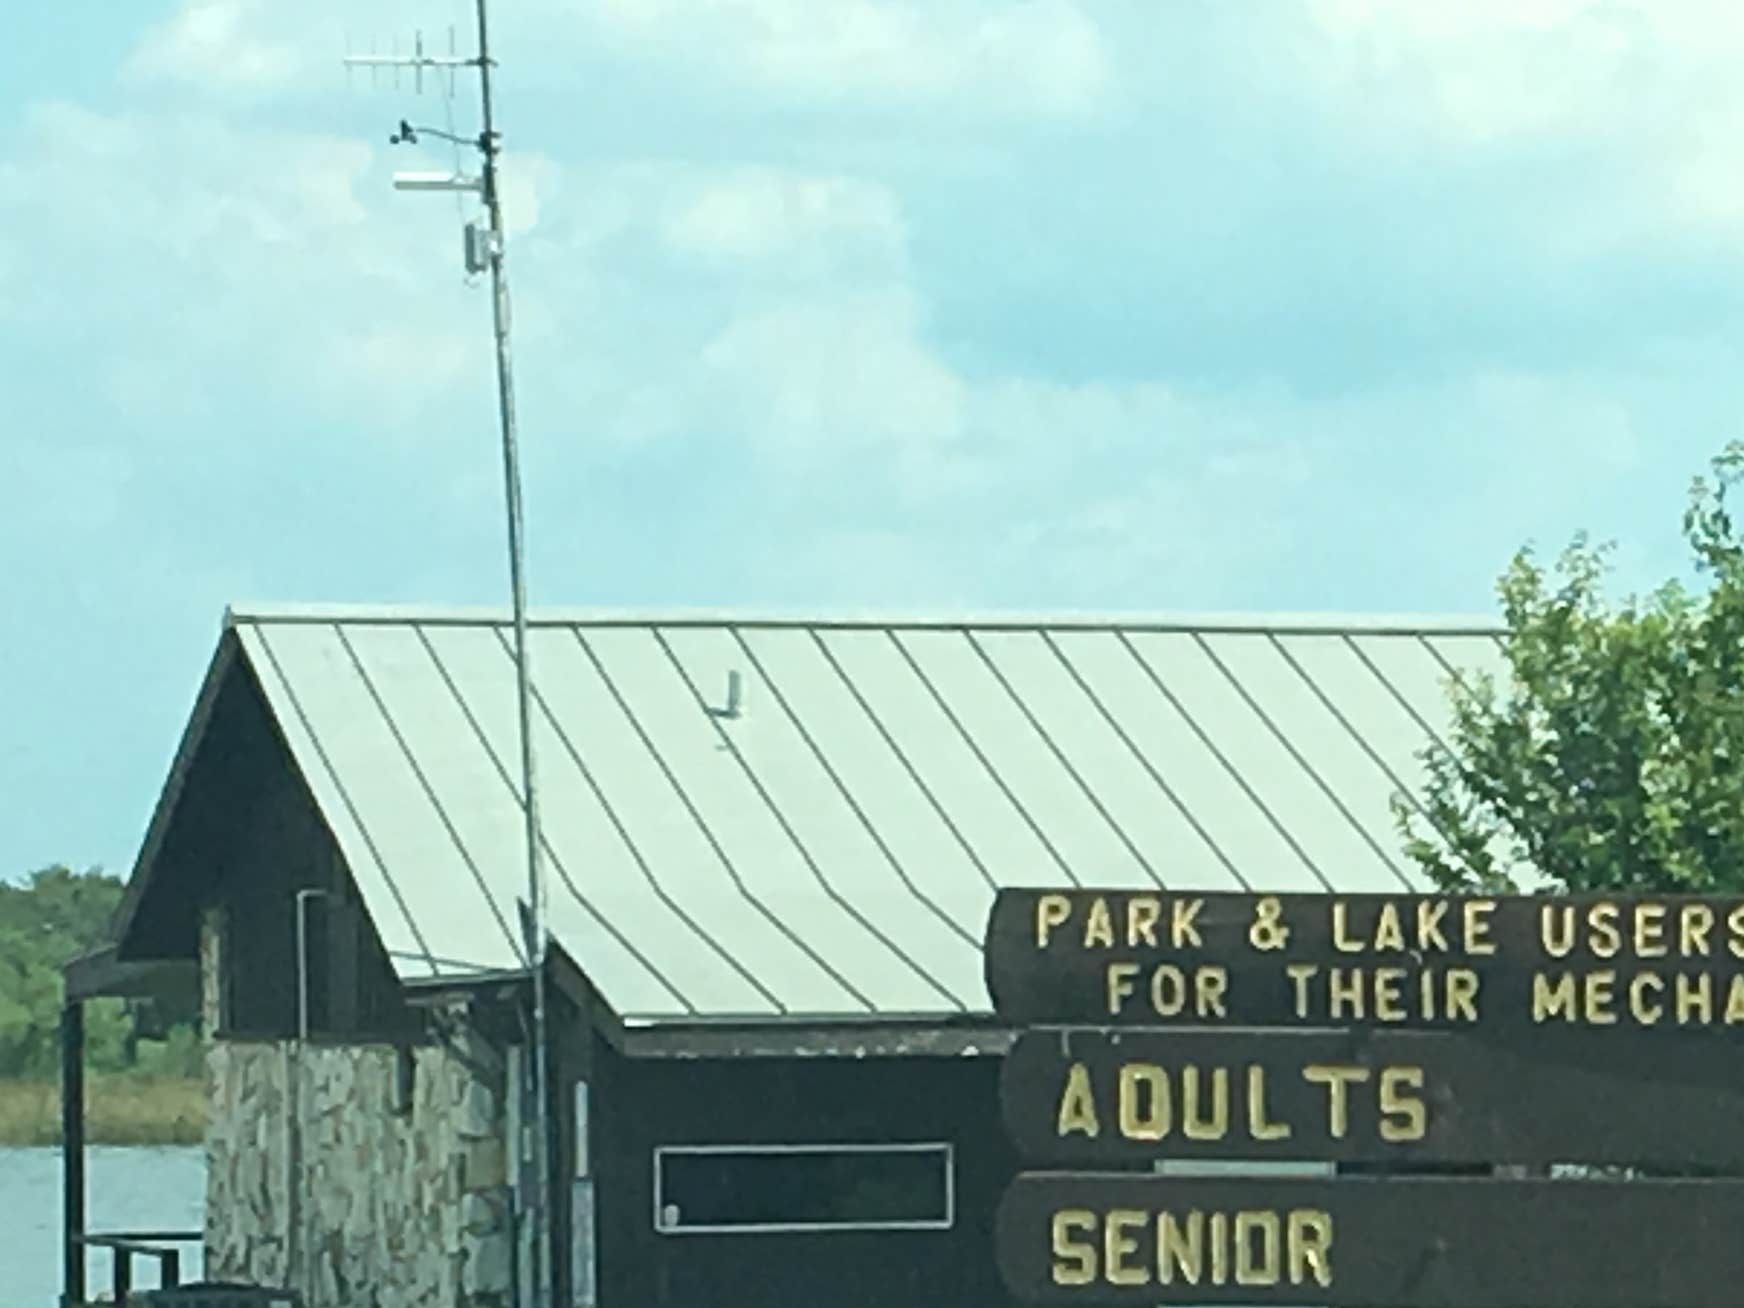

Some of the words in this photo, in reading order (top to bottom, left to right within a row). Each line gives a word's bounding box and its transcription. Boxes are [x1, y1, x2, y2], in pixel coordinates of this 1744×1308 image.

[1036, 896, 1202, 948] PARK
[1249, 897, 1290, 949] &
[1333, 900, 1498, 955] LAKE
[1107, 963, 1228, 1016] FOR
[1288, 965, 1480, 1021] THEIR
[1051, 1209, 1334, 1288] SENIOR
